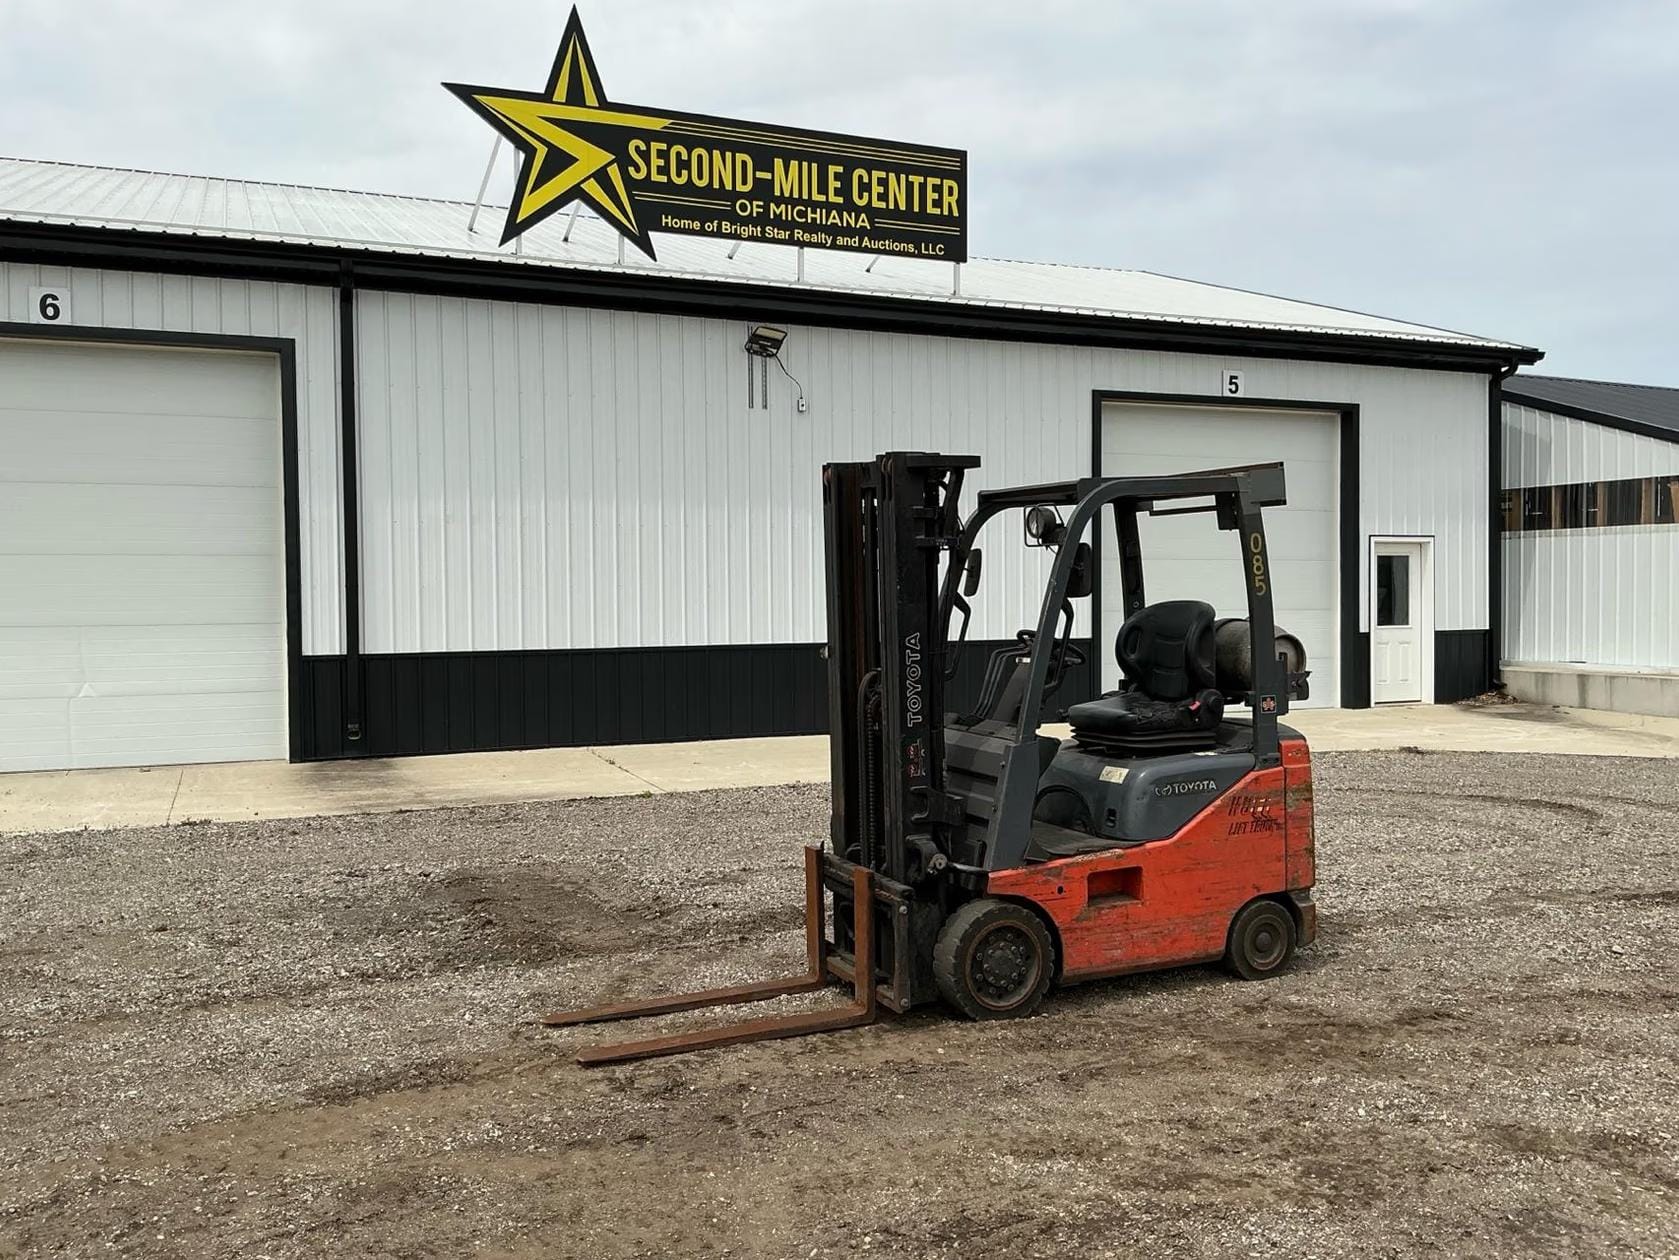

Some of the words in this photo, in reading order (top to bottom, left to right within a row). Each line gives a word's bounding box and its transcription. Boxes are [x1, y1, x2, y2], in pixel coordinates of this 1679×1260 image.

[627, 138, 844, 204] SECOND-MILE
[852, 168, 960, 217] CENTER
[735, 199, 764, 217] OF
[769, 202, 871, 230] MICHIANA
[661, 214, 701, 231] Home
[704, 220, 719, 232] of
[721, 221, 762, 239] Bright
[765, 226, 791, 240] Star
[794, 229, 833, 247] Realty
[836, 236, 859, 247] and
[861, 236, 919, 254] Auctions,
[921, 242, 945, 255] LLC
[39, 293, 61, 321] 6
[1228, 375, 1239, 394] 5
[1250, 532, 1267, 596] 085
[905, 632, 923, 728] TOYOTA
[1173, 780, 1217, 795] TOYOTA
